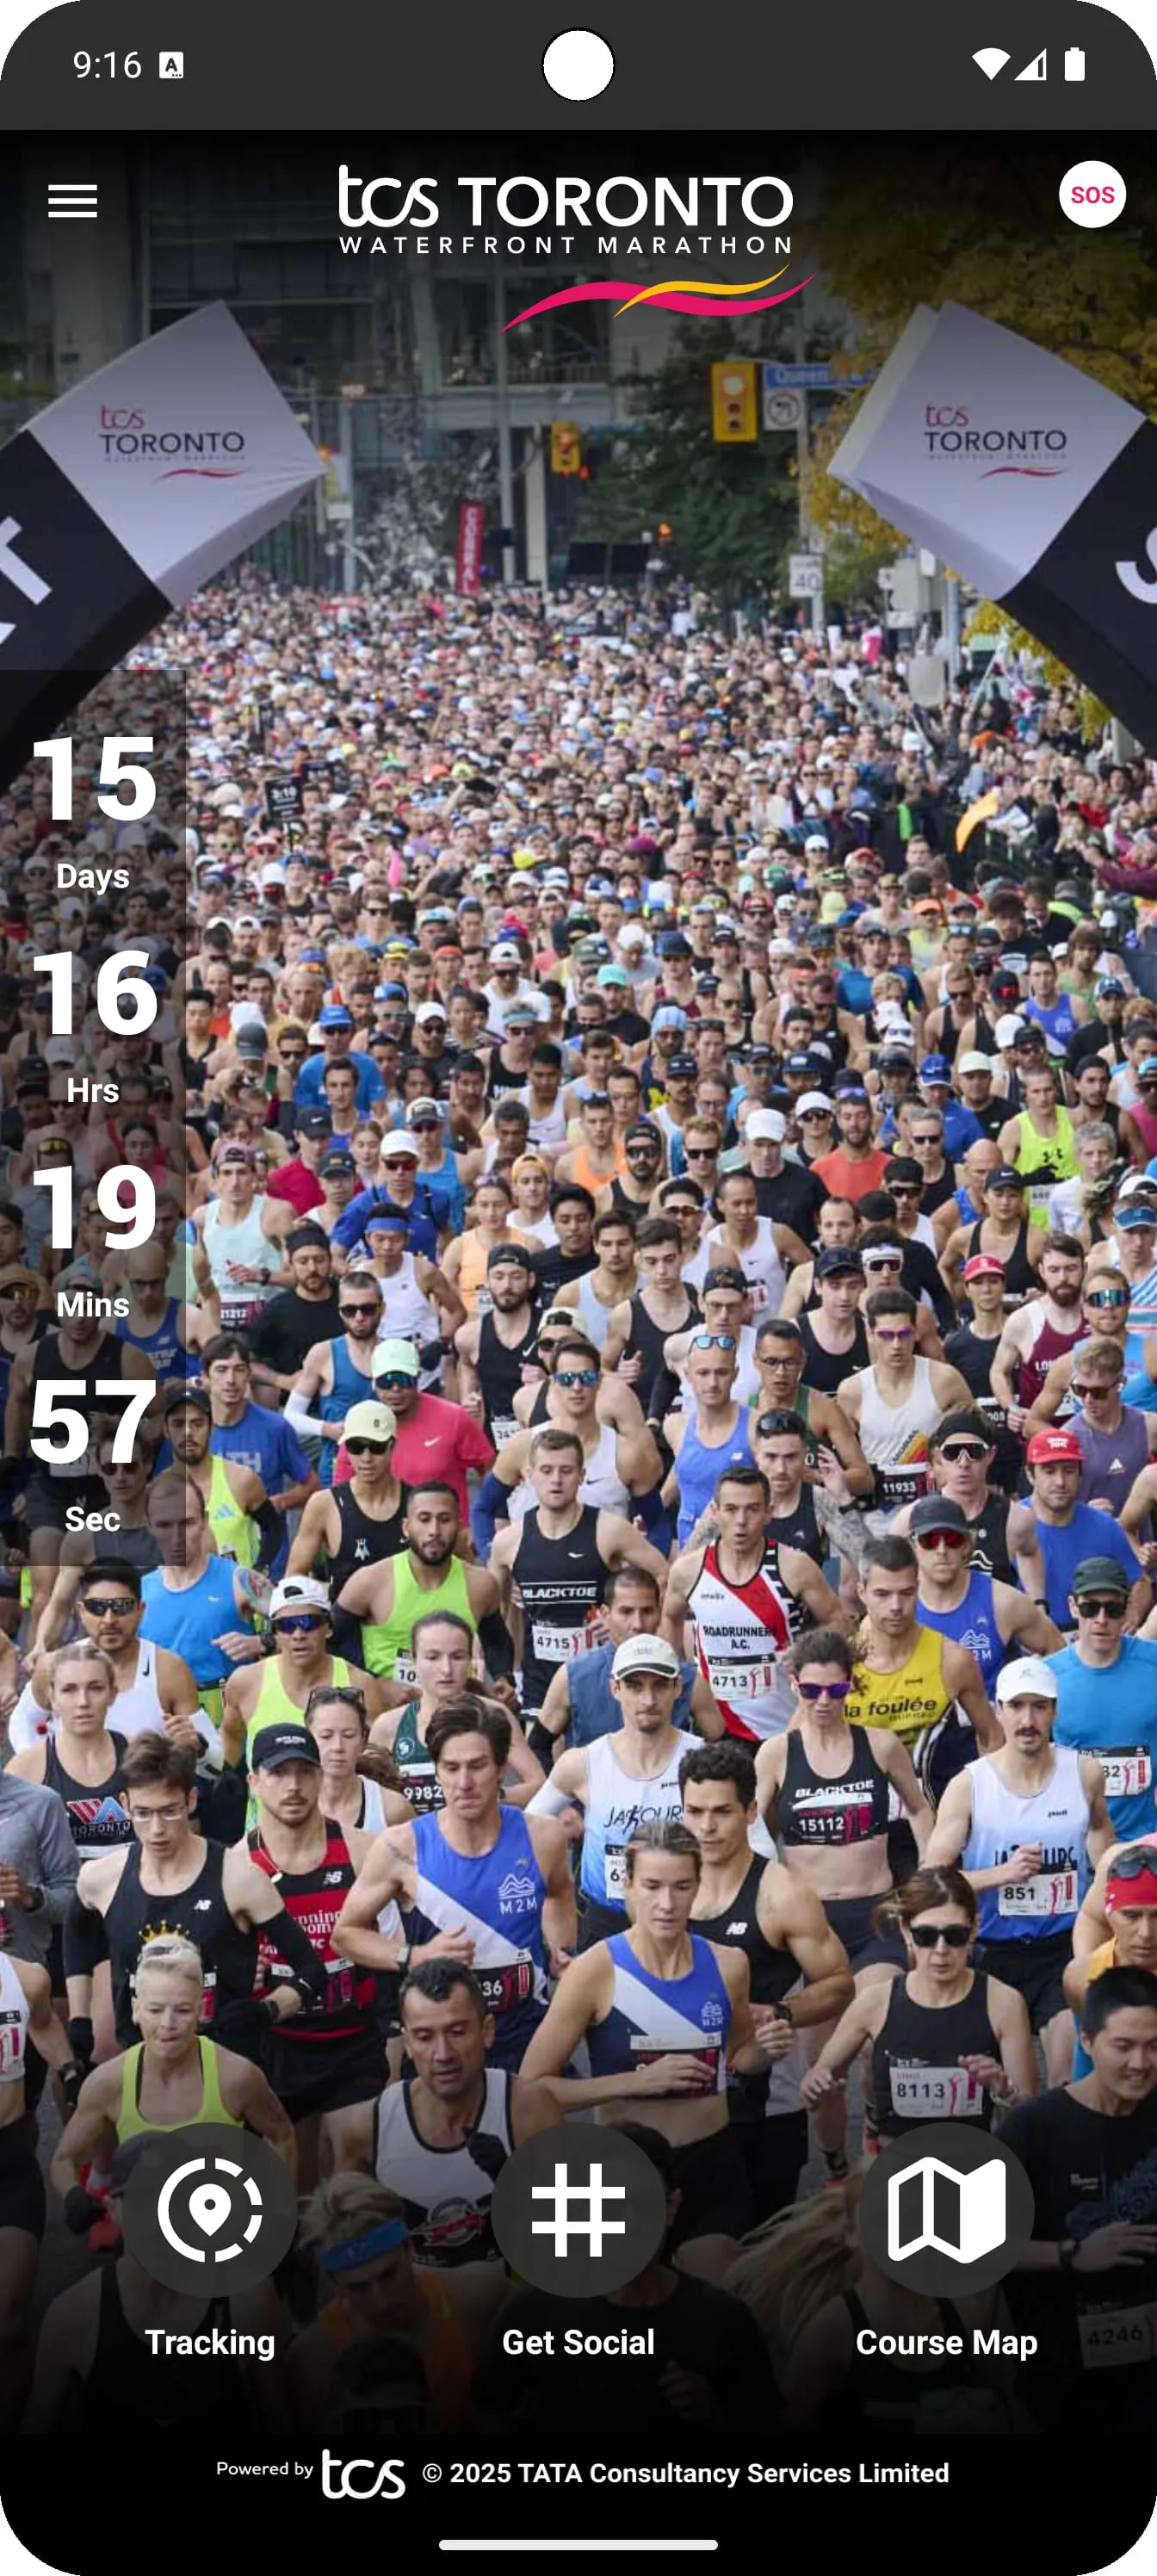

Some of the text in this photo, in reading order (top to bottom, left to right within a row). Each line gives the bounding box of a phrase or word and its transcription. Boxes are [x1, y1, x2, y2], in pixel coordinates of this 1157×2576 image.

[101, 405, 144, 430] tcs
[926, 405, 968, 427] tcs
[99, 432, 245, 454] TORONTO
[924, 430, 1067, 452] TORONTO
[794, 573, 820, 591] 40
[883, 1481, 916, 1493] 11933
[523, 1588, 597, 1599] BLACKTOE
[537, 1636, 570, 1650] 4715
[713, 1675, 748, 1687] 4713
[845, 1696, 937, 1717] la foulée
[404, 1786, 443, 1800] 9982
[795, 1779, 875, 1798] BLACKTOE
[799, 1817, 845, 1832] 15112
[1004, 1886, 1036, 1901] 851
[499, 1898, 538, 1916] M2M
[897, 2083, 945, 2098] 8113
[1087, 2323, 1144, 2345] 4246
